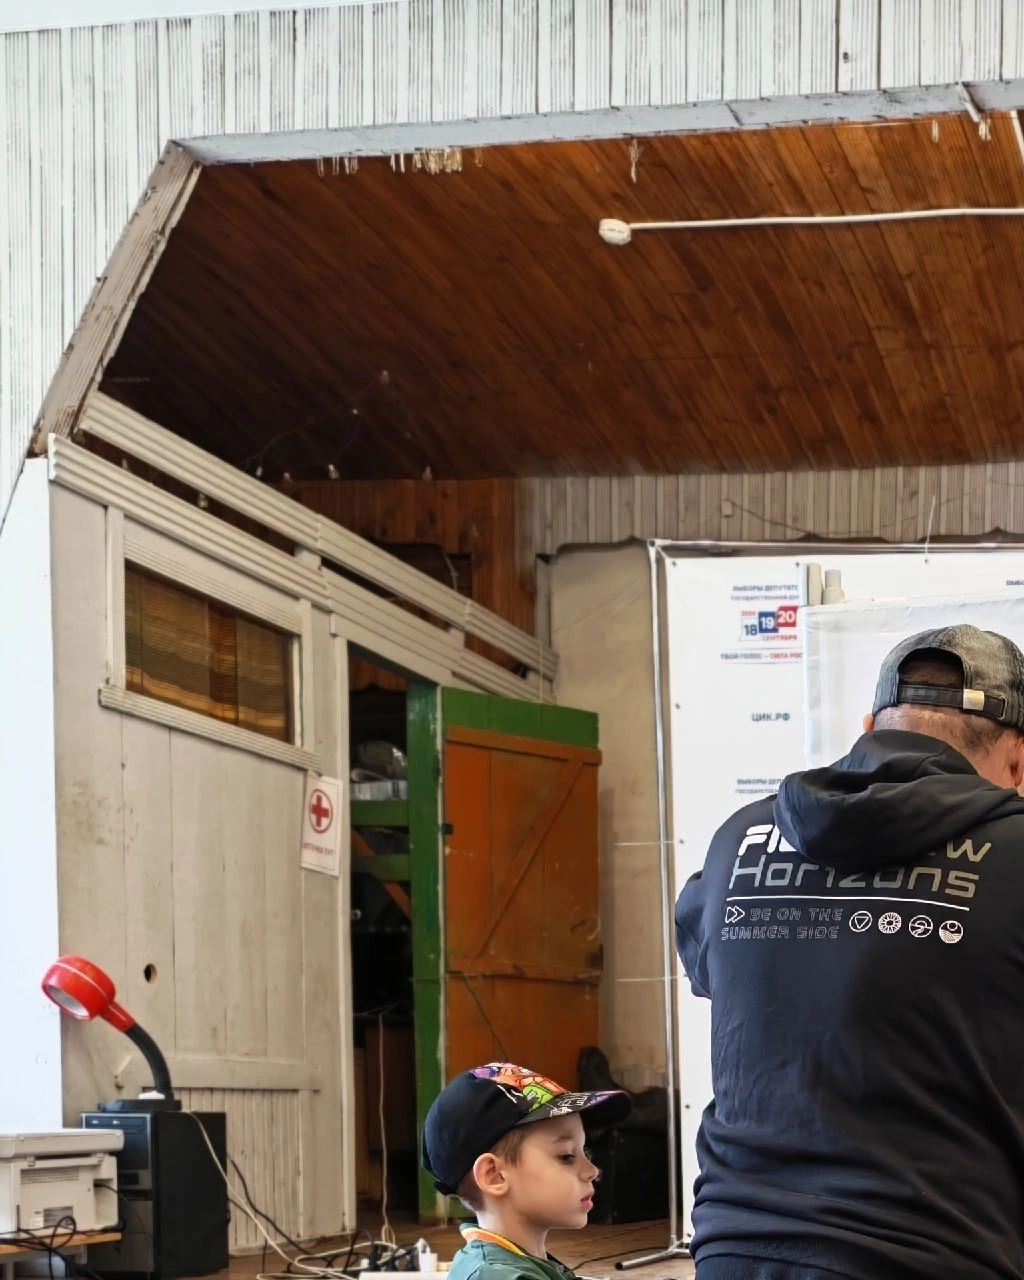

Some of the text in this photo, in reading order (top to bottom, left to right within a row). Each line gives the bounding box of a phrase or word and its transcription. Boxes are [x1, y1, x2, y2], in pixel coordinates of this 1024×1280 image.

[744, 611, 795, 636] 18 19 20
[752, 713, 790, 722] ЦИК.РФ
[728, 854, 980, 898] Horizons
[749, 908, 844, 921] BE ON THE
[721, 926, 840, 940] SUMMER SIDE
